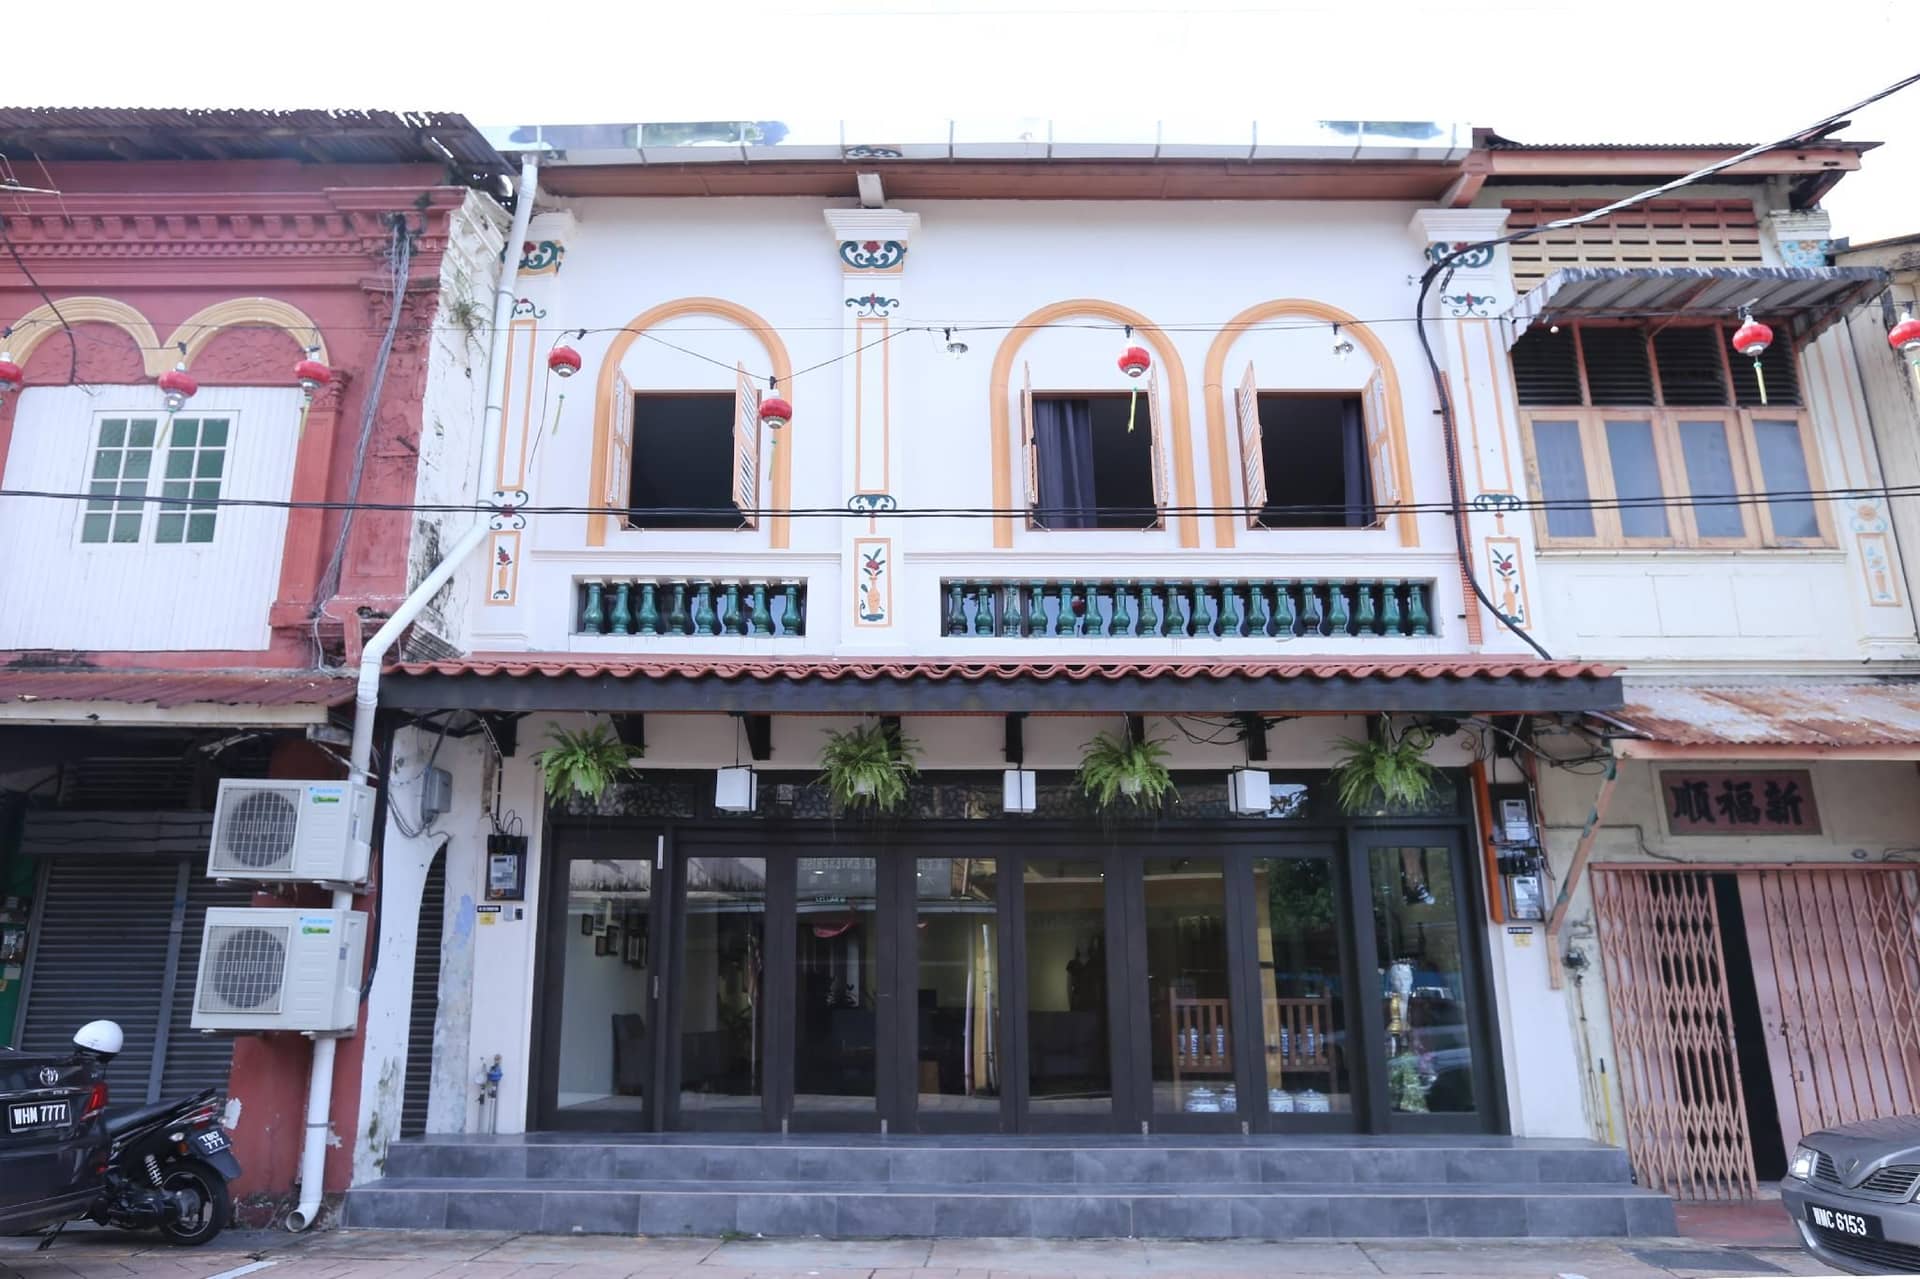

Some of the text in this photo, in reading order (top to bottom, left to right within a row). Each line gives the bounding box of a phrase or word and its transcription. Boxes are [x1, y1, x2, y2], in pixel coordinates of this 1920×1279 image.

[13, 1104, 66, 1125] WHM 7777
[204, 1137, 225, 1150] 777
[1812, 1206, 1867, 1236] WMC 6153
